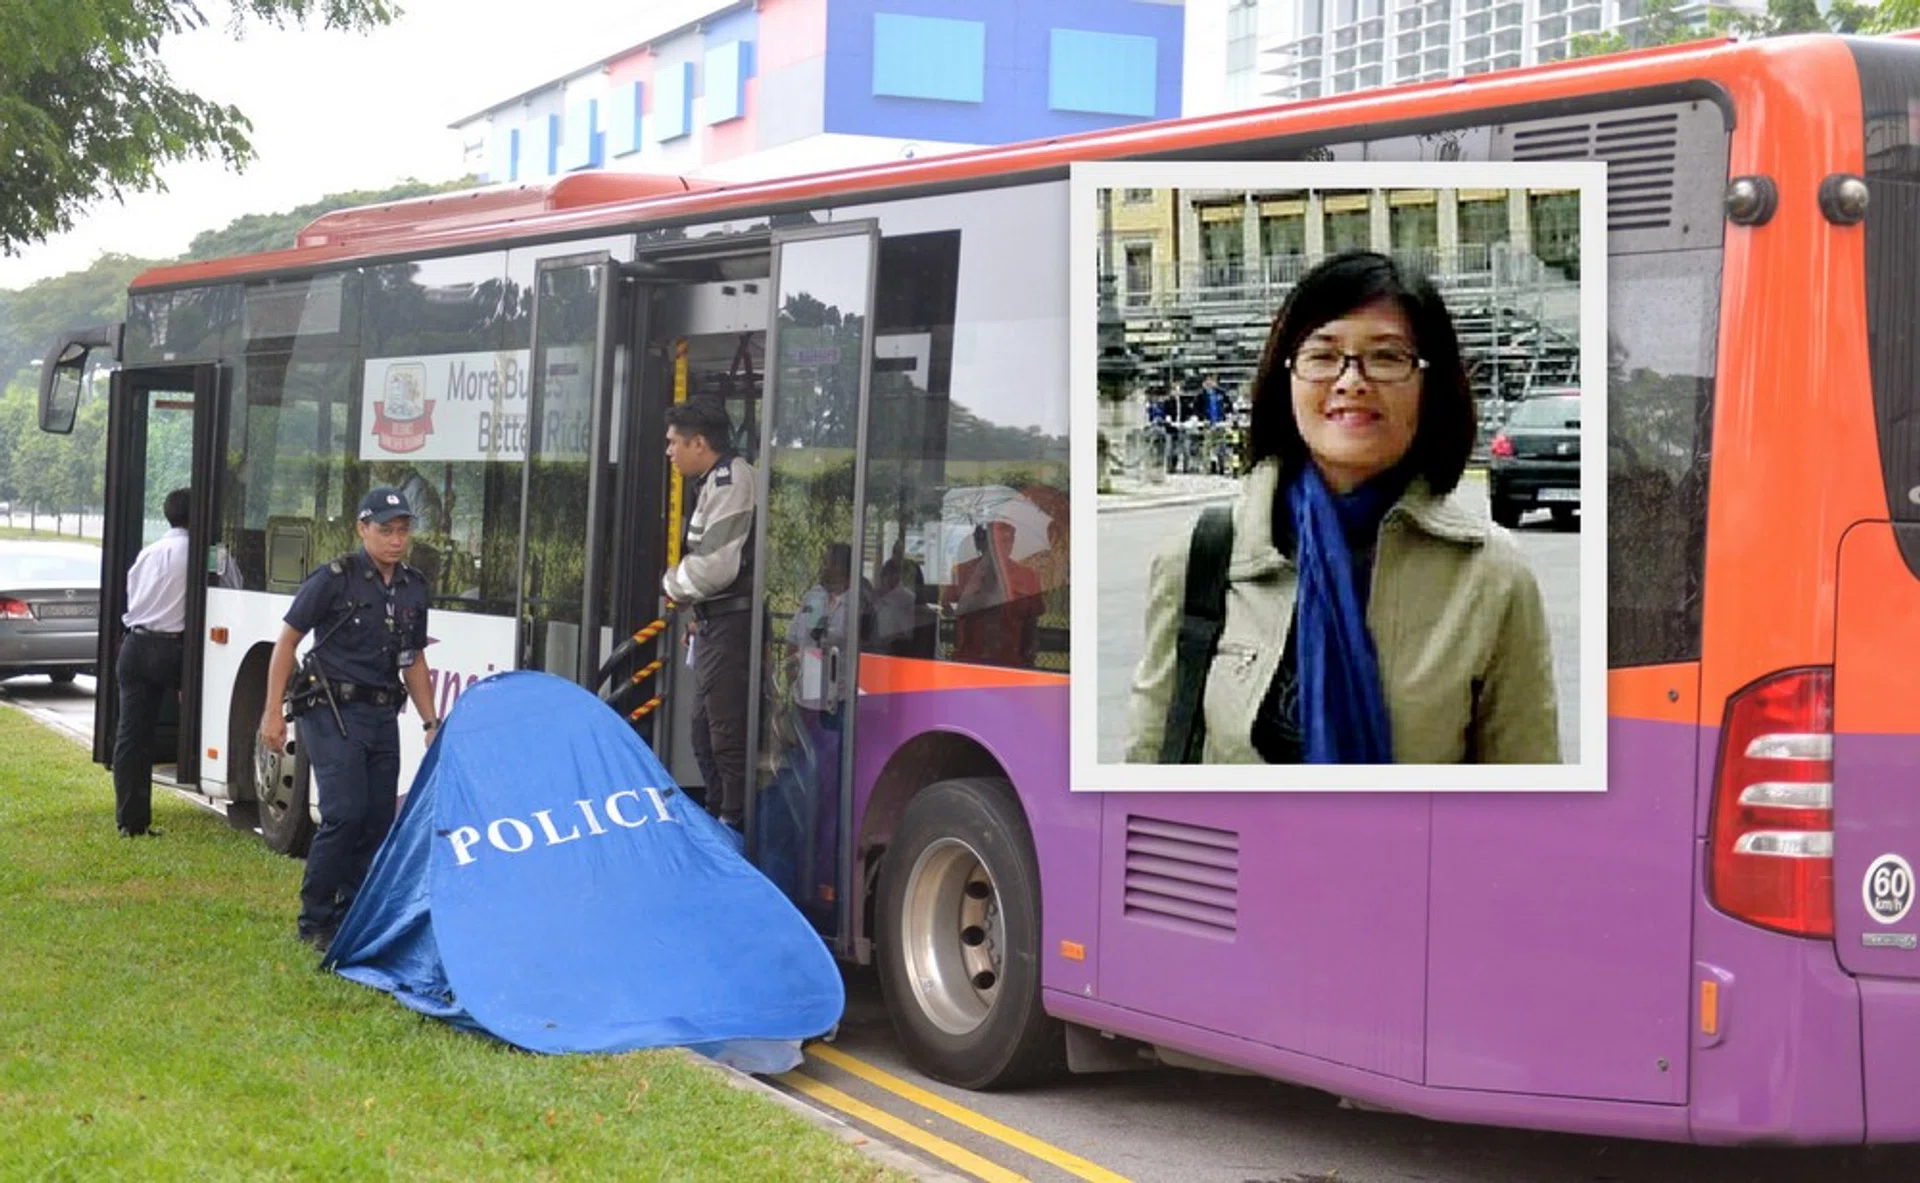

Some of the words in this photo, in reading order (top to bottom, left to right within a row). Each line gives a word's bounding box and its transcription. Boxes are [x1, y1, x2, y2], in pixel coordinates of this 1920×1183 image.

[447, 360, 498, 401] More
[1874, 867, 1907, 898] 60
[1875, 896, 1903, 911] km/h
